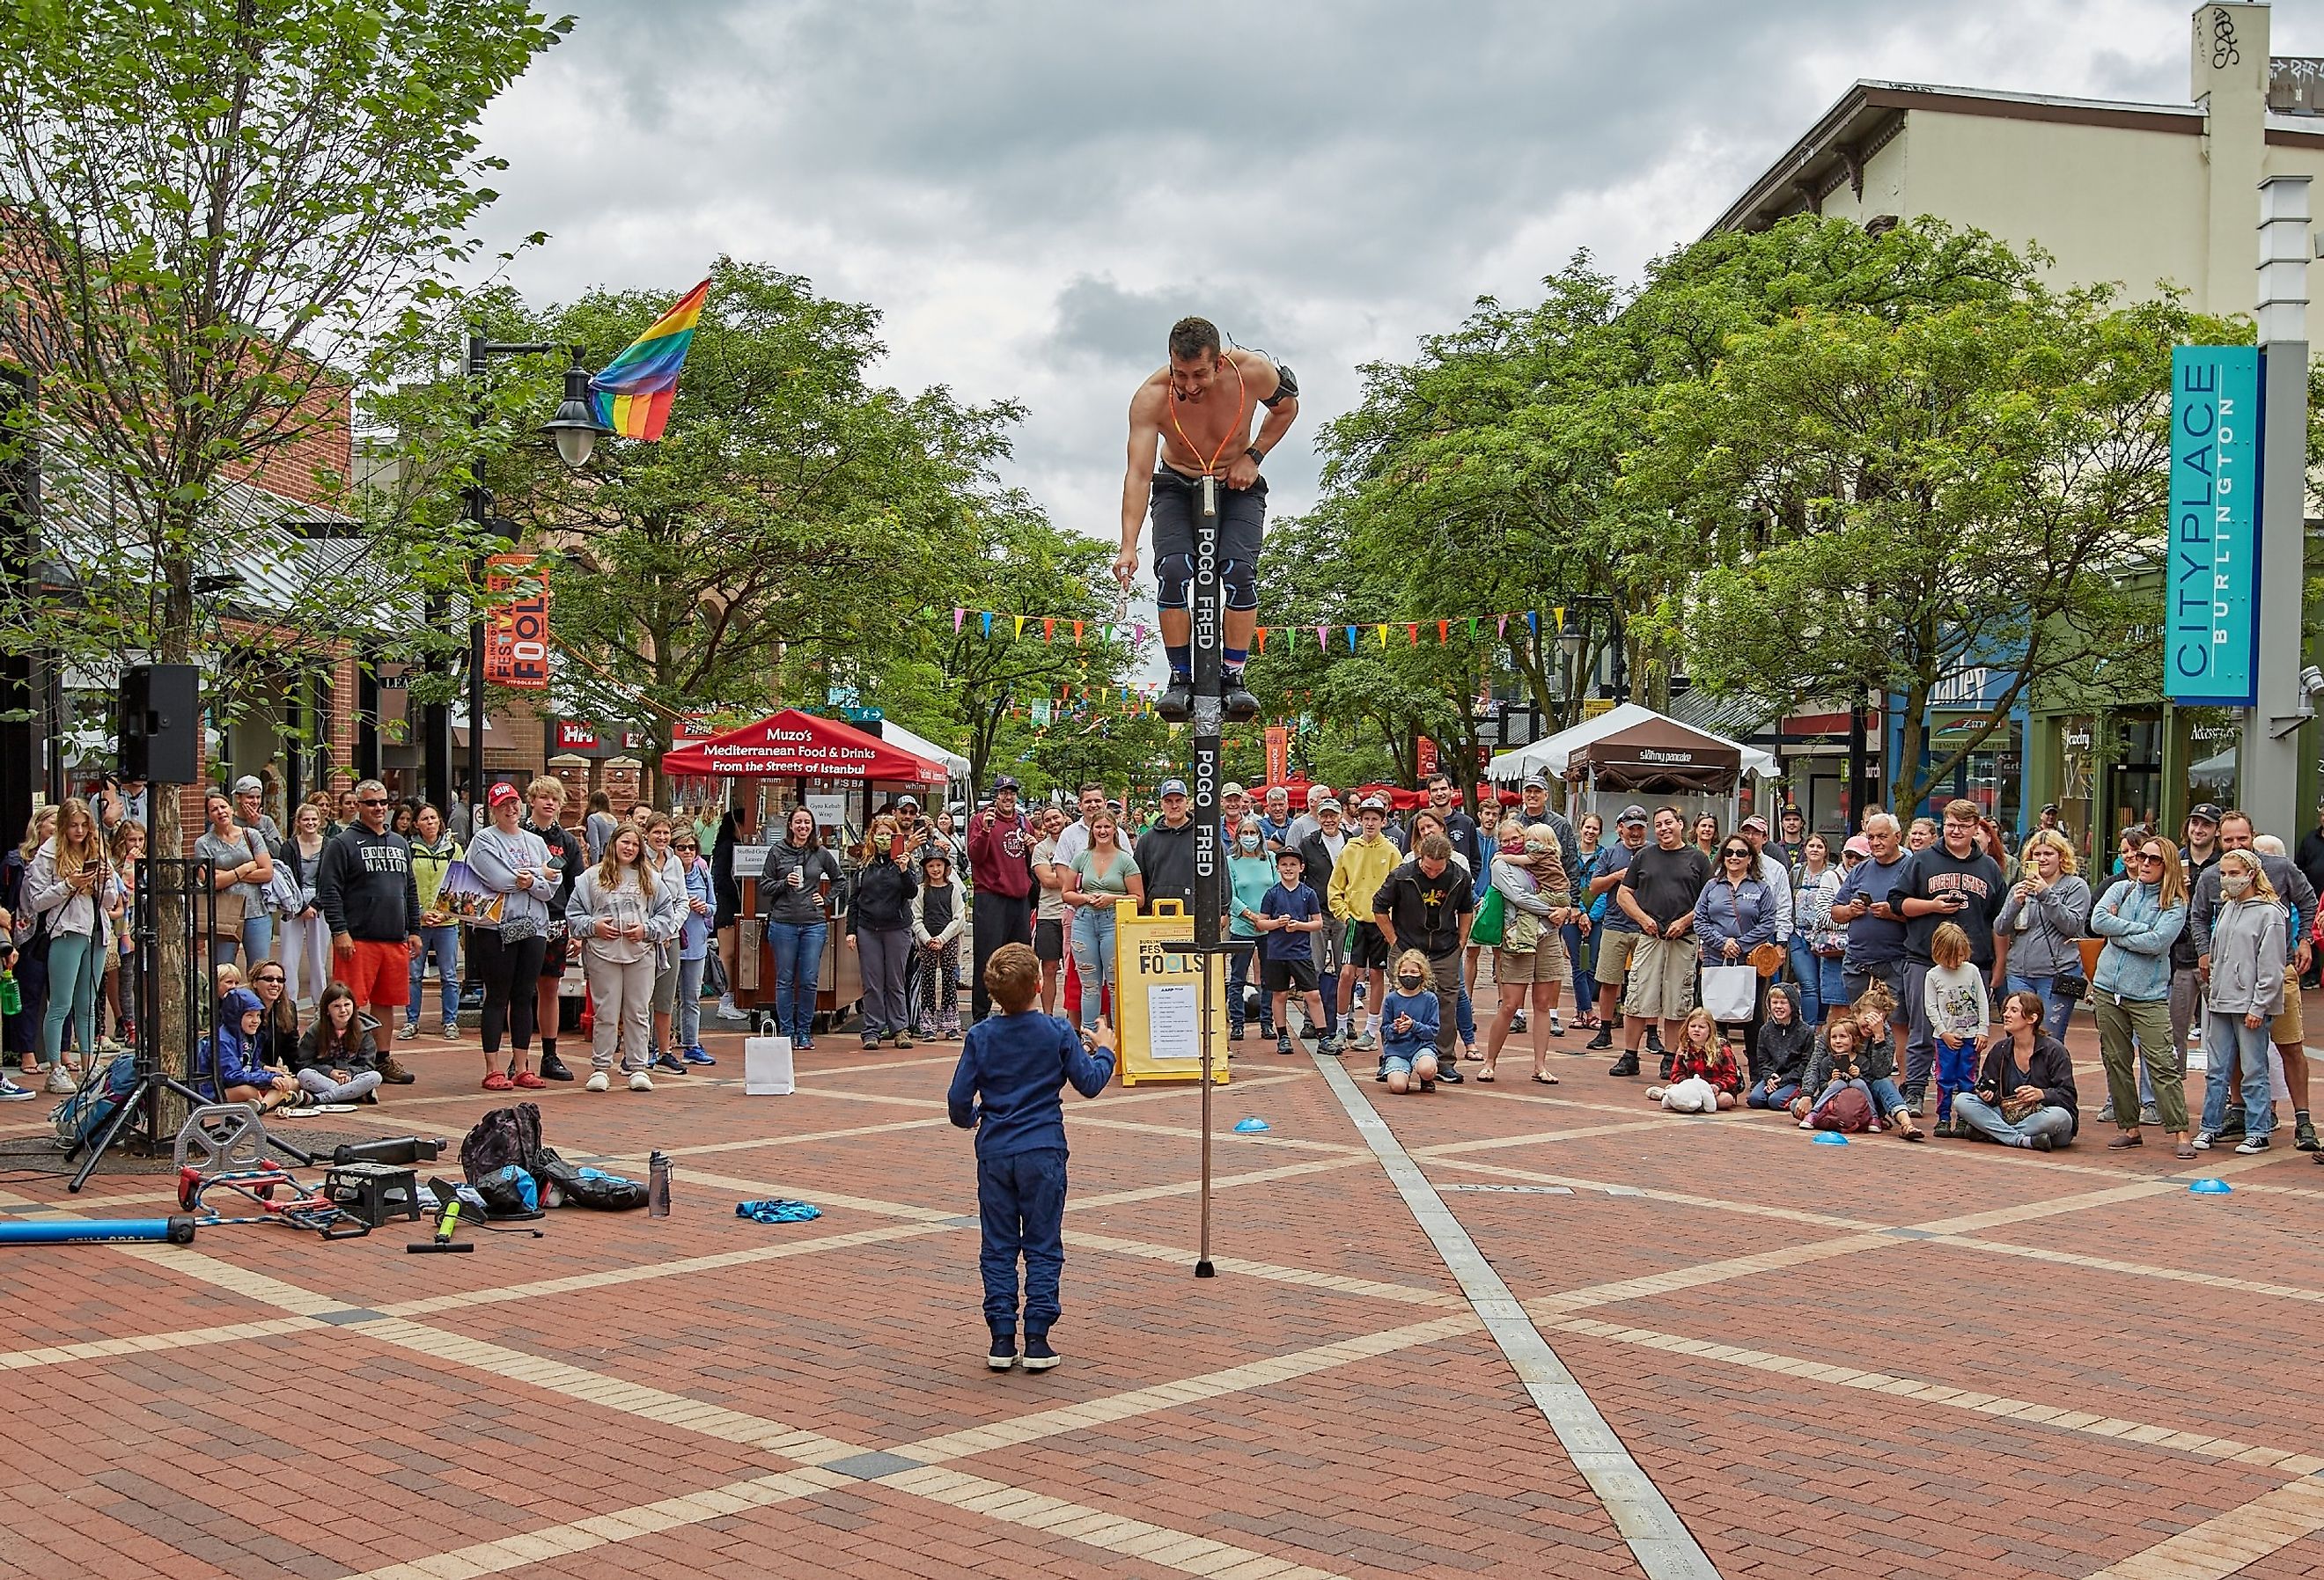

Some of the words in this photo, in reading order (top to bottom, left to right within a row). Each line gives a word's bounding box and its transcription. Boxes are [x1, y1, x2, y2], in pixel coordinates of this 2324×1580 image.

[2176, 364, 2215, 678] CITYPLACE
[2213, 398, 2234, 644] BURLINGTON
[1197, 527, 1216, 586] POGO
[513, 597, 545, 679] FOOL
[1197, 595, 1215, 650] FRED
[386, 677, 410, 688] LEA
[703, 745, 796, 756] Mediterranean
[798, 746, 827, 758] Food
[828, 746, 839, 758] &
[841, 747, 876, 759] Drinks
[712, 761, 743, 771] From
[745, 761, 764, 771] the
[765, 761, 804, 772] Streets
[805, 763, 819, 773] of
[820, 763, 865, 775] Istanbul
[1195, 749, 1215, 808] POGO
[1666, 752, 1692, 763] pancake
[1195, 824, 1214, 878] FRED
[1928, 872, 1960, 894] OREGON
[1961, 873, 1988, 900] STATE
